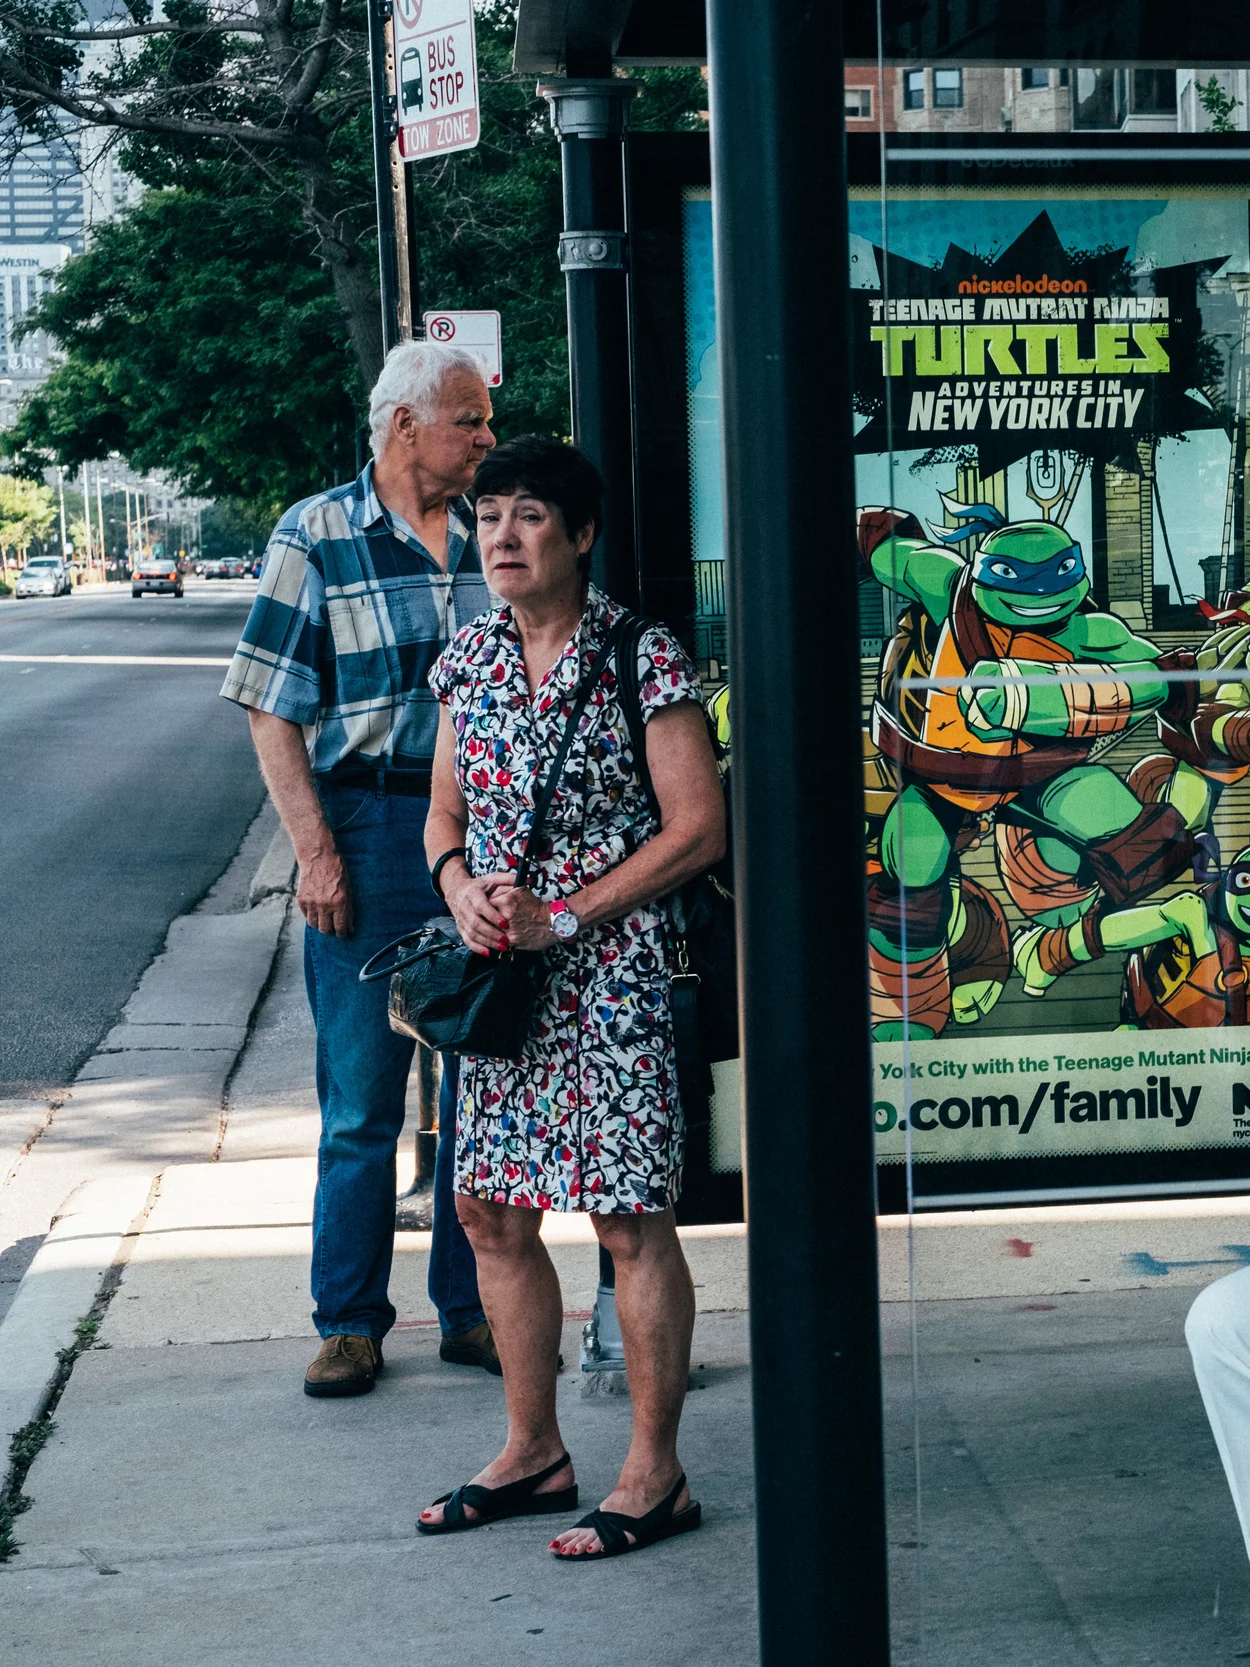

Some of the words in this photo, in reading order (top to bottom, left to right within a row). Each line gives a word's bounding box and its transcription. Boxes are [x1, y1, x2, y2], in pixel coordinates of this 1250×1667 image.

[428, 35, 455, 73] BUS
[429, 71, 464, 110] STOP
[403, 124, 429, 153] TOW
[437, 113, 472, 146] ZONE
[0, 258, 40, 267] WESTIN
[958, 274, 1088, 294] nickelodeon
[868, 298, 976, 321] TEENAGE
[983, 297, 1088, 320] MUTANT
[1093, 297, 1170, 319] NINJA
[870, 323, 1170, 377] TURTLES
[938, 380, 1093, 397] ADVENTURES
[1099, 379, 1121, 395] IN
[907, 390, 984, 431] NEW
[988, 396, 1074, 430] YORK
[1076, 388, 1145, 429] CITY
[927, 1060, 968, 1080] City
[972, 1058, 1015, 1075] with
[1018, 1056, 1050, 1073] the
[1053, 1054, 1134, 1072] Teenage
[1138, 1049, 1206, 1068] Mutant
